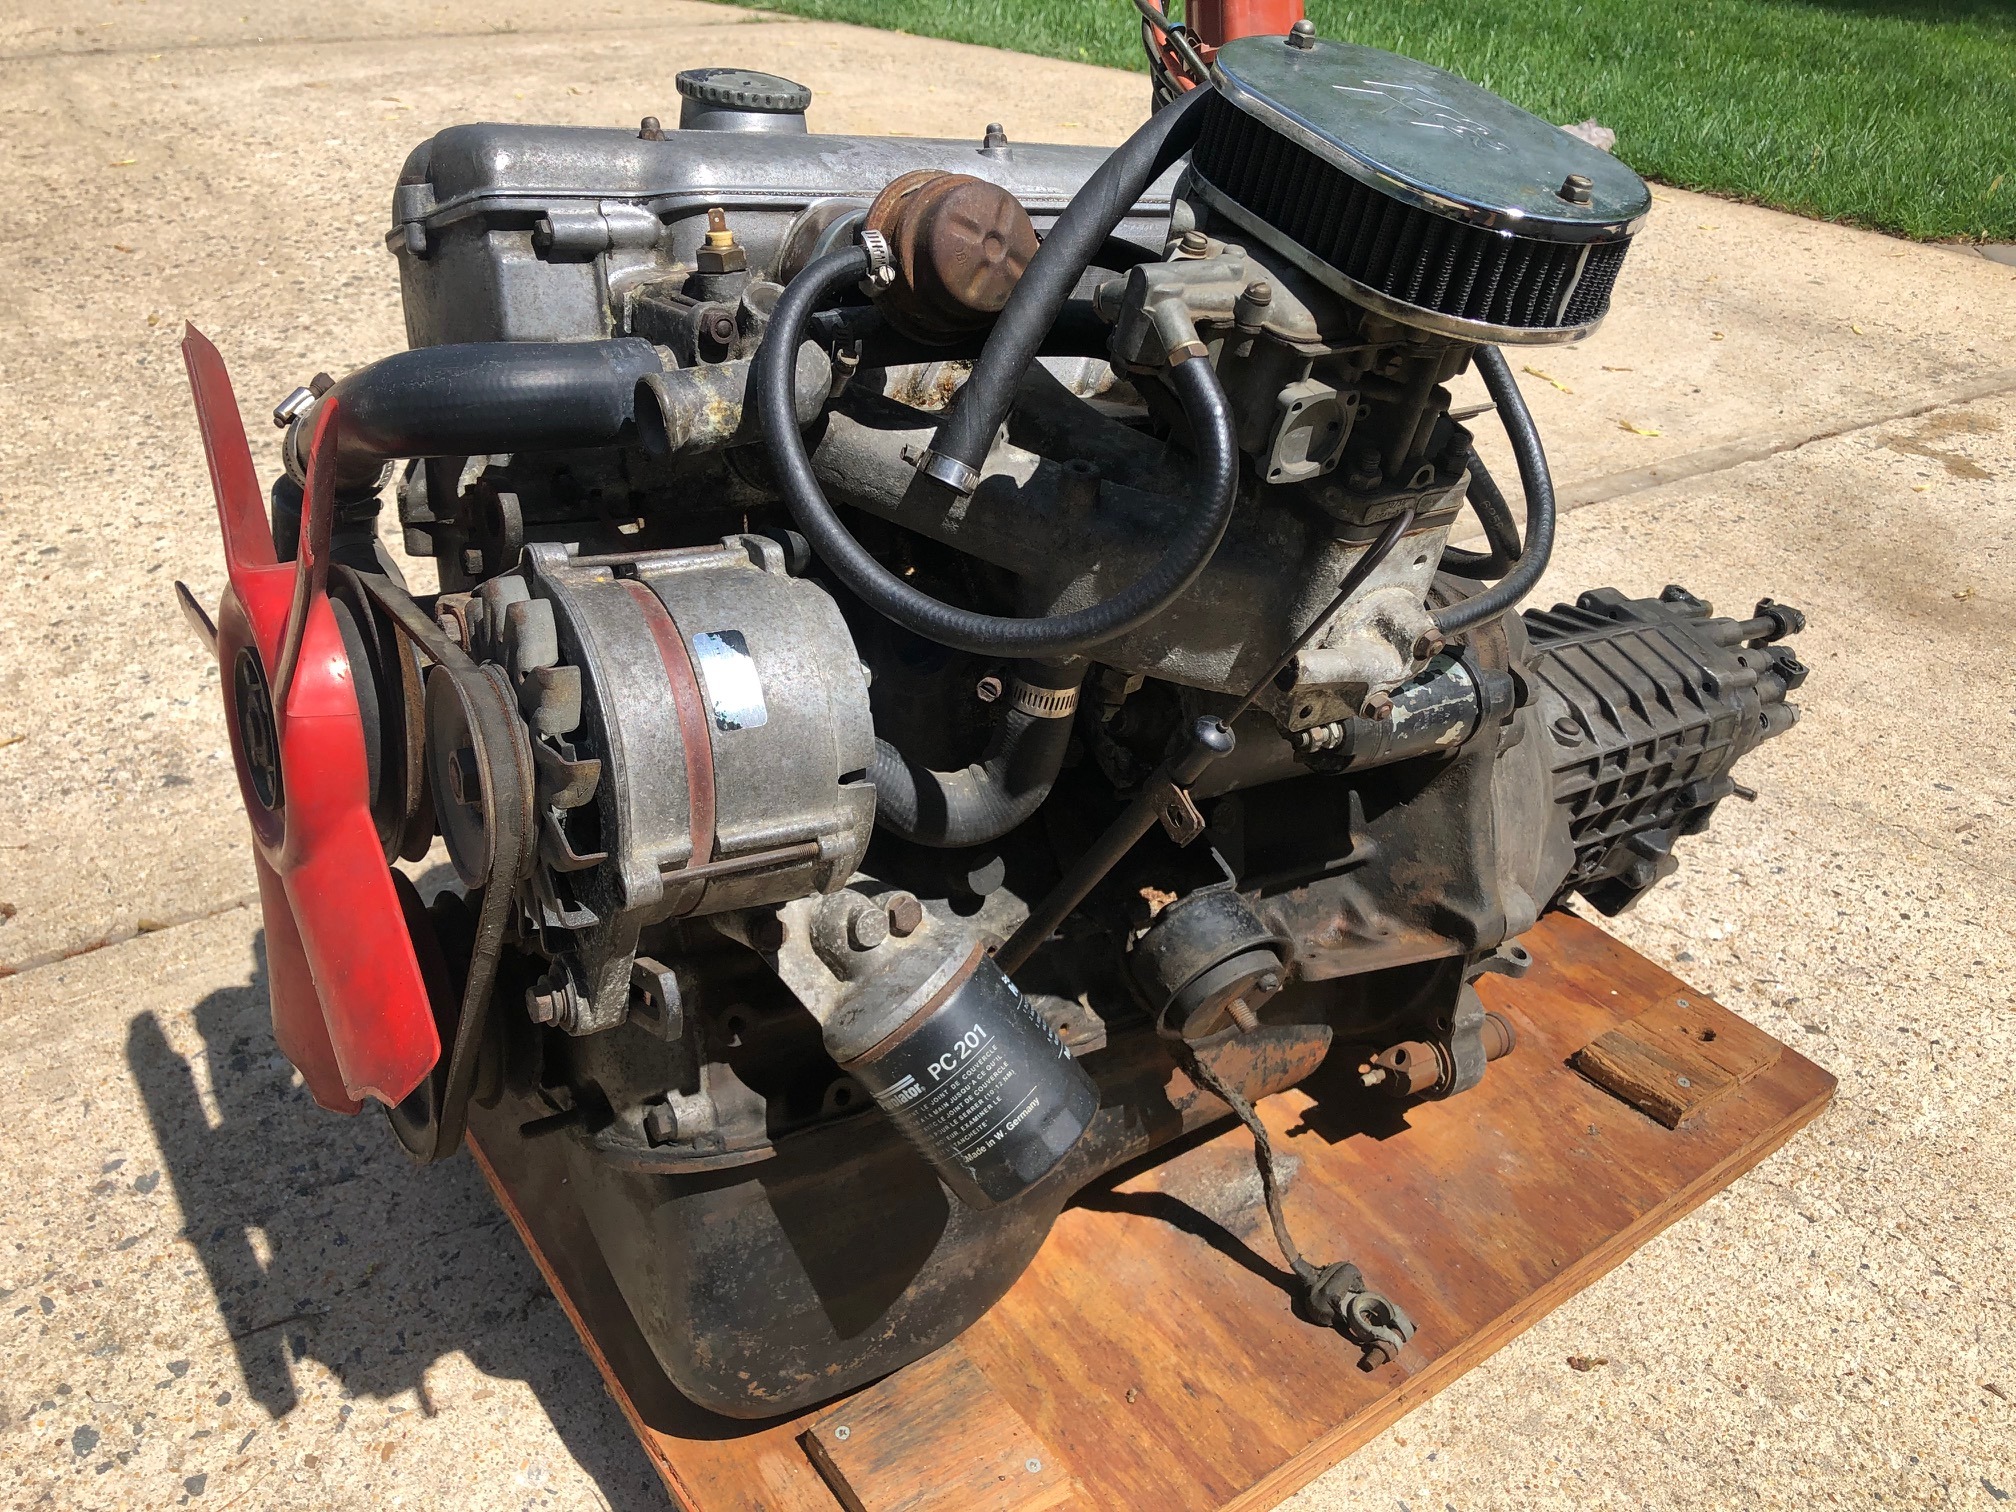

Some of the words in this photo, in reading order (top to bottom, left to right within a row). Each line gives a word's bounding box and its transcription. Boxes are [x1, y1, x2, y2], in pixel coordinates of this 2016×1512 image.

[921, 1104, 930, 1112] LE
[930, 1089, 949, 1106] JOINT
[950, 1080, 961, 1090] DE
[962, 1044, 998, 1080] COUVERCLE
[927, 1053, 957, 1081] PC
[954, 1024, 987, 1060] 201
[932, 1102, 950, 1116] MAIN
[949, 1079, 977, 1104] JUSQU'A
[976, 1070, 987, 1081] CE
[985, 1053, 1003, 1071] QU'IL
[937, 1116, 946, 1125] LE
[946, 1102, 965, 1119] JOINT
[964, 1094, 974, 1104] DE
[973, 1060, 1009, 1096] COUVERCLE
[950, 1118, 959, 1127] LE
[958, 1098, 985, 1121] SERRER
[960, 1103, 994, 1132] EXAMINER
[993, 1096, 1003, 1106] LE
[964, 1145, 987, 1163] Made
[985, 1139, 996, 1148] in
[994, 1130, 1008, 1141] W.
[1006, 1097, 1040, 1131] Germany
